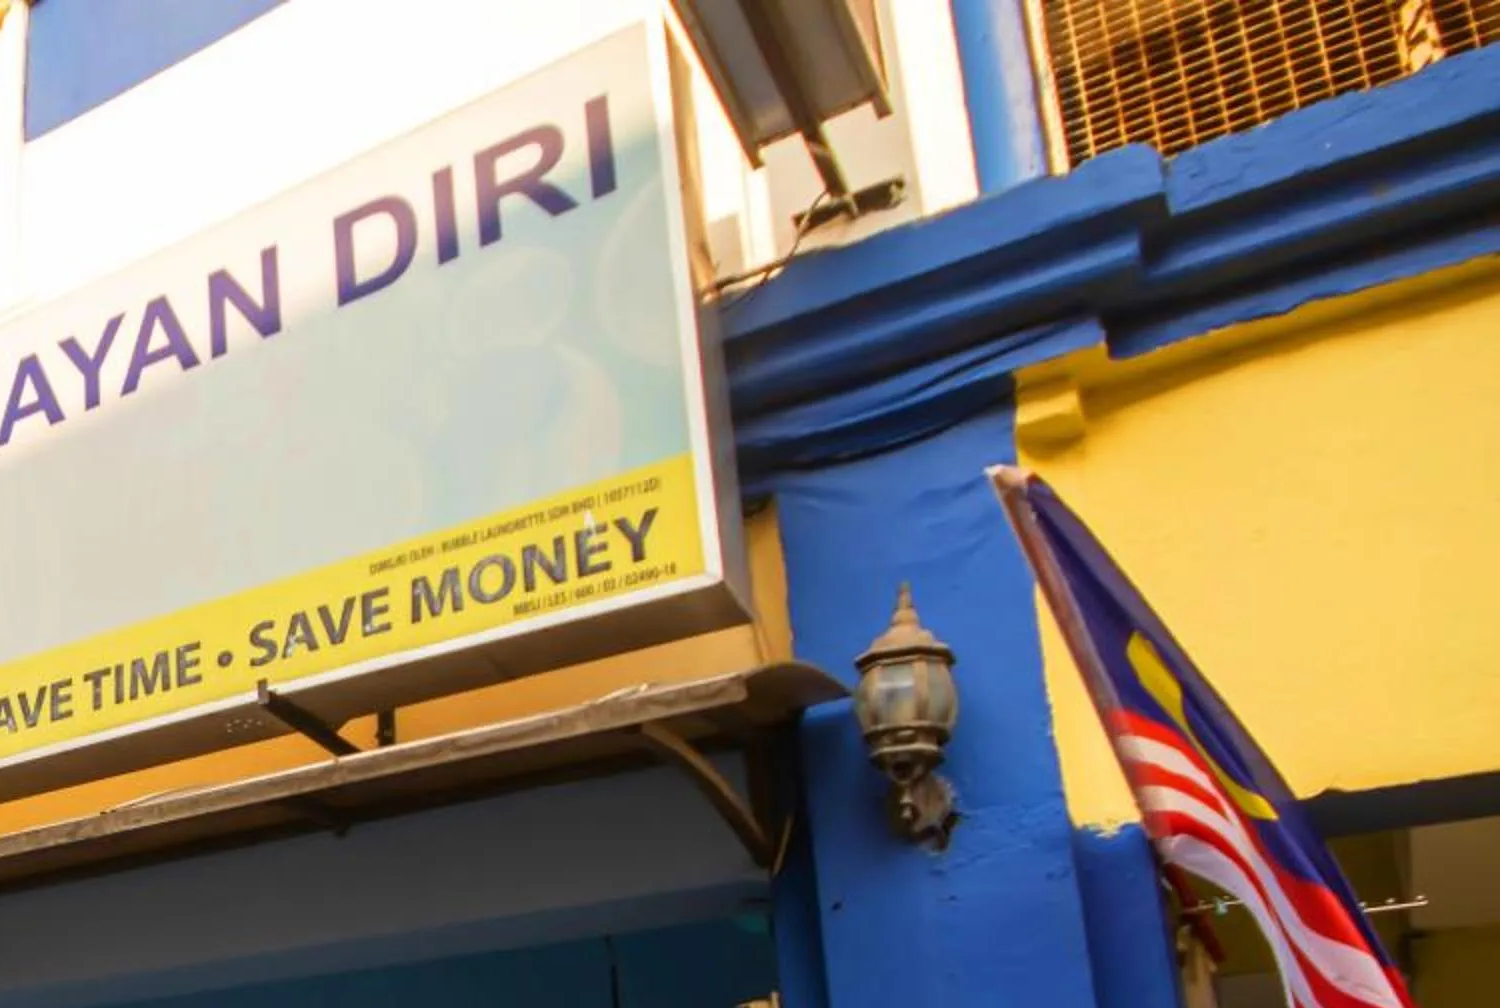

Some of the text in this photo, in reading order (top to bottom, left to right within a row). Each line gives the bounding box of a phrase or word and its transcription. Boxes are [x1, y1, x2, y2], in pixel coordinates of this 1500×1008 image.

[333, 92, 618, 308] DIRI
[83, 641, 203, 712] TIME
[248, 586, 393, 668] SAVE
[411, 507, 660, 626] MONEY
